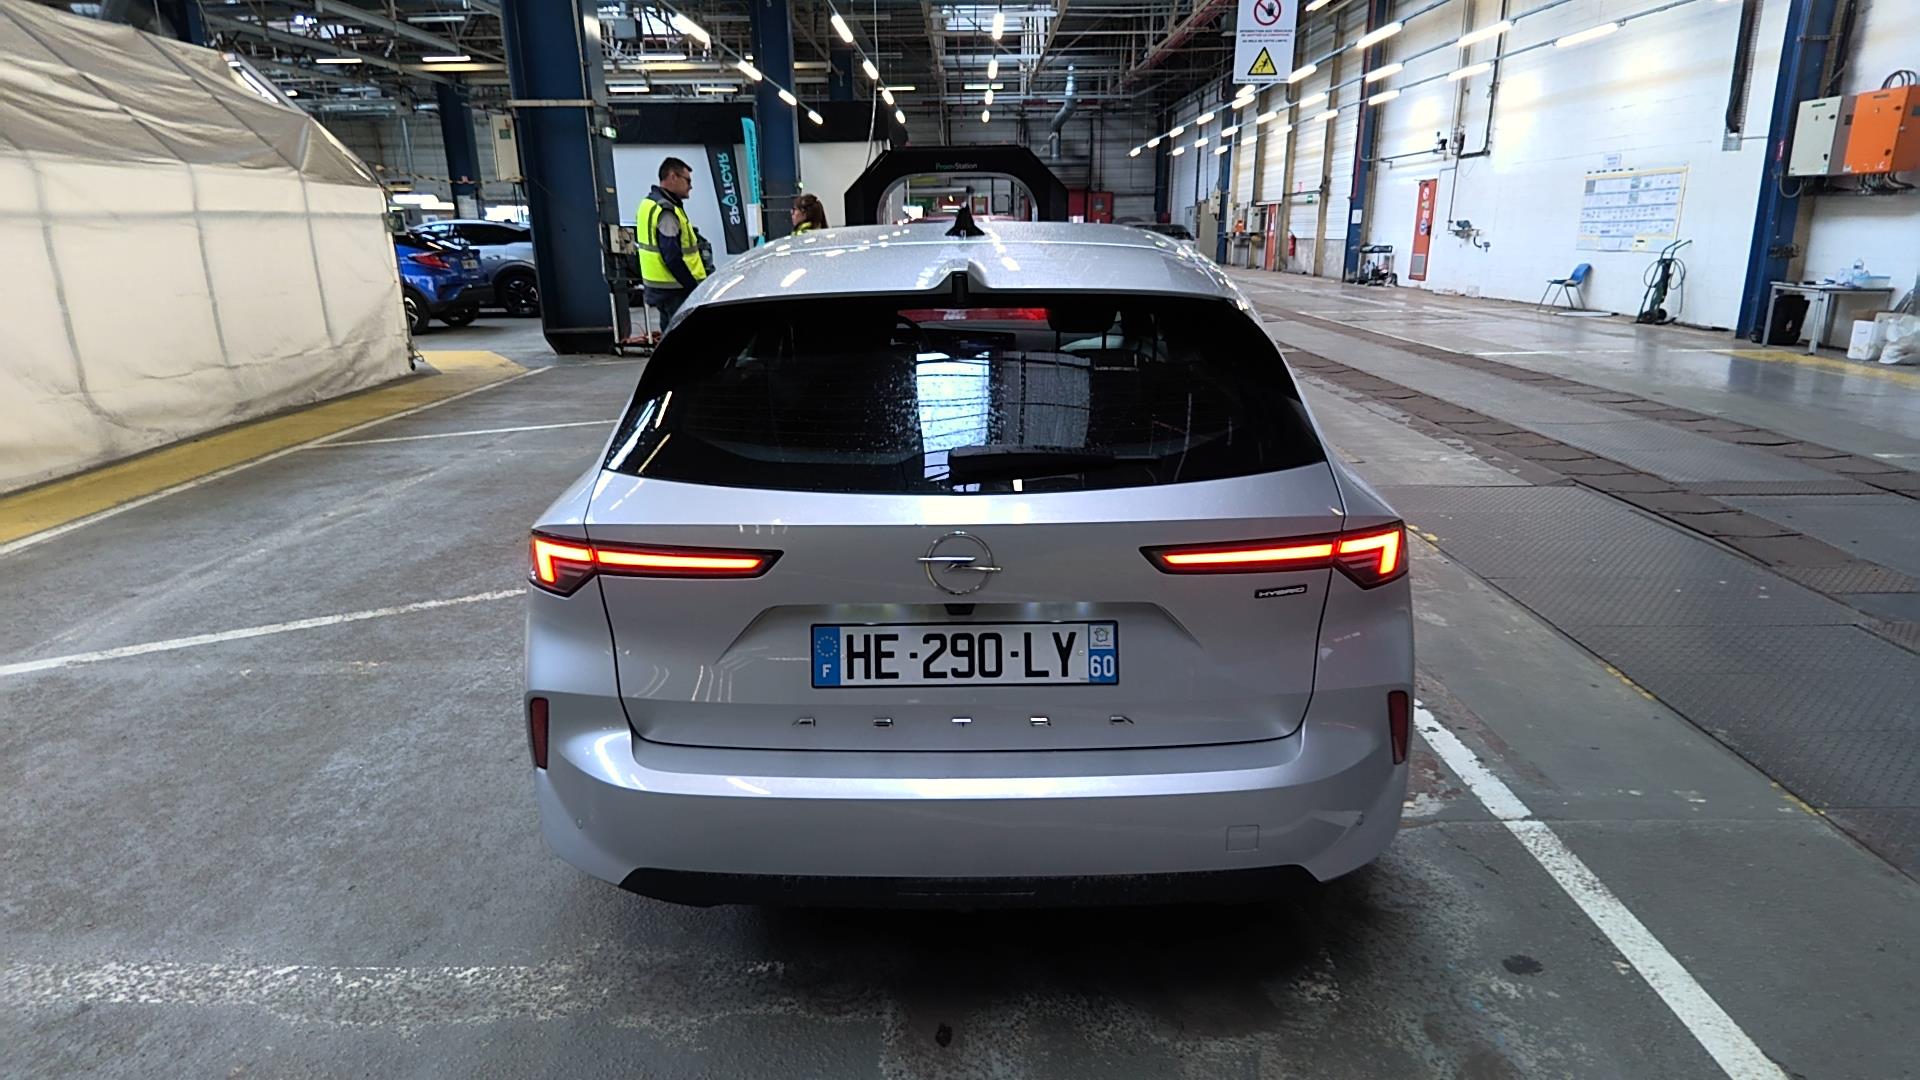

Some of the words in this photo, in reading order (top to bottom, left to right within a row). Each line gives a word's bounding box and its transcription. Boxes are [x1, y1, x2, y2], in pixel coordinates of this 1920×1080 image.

[1258, 586, 1305, 597] HYBRID
[845, 631, 1077, 680] HE-290-LY
[822, 663, 832, 678] F
[1089, 654, 1113, 677] 60
